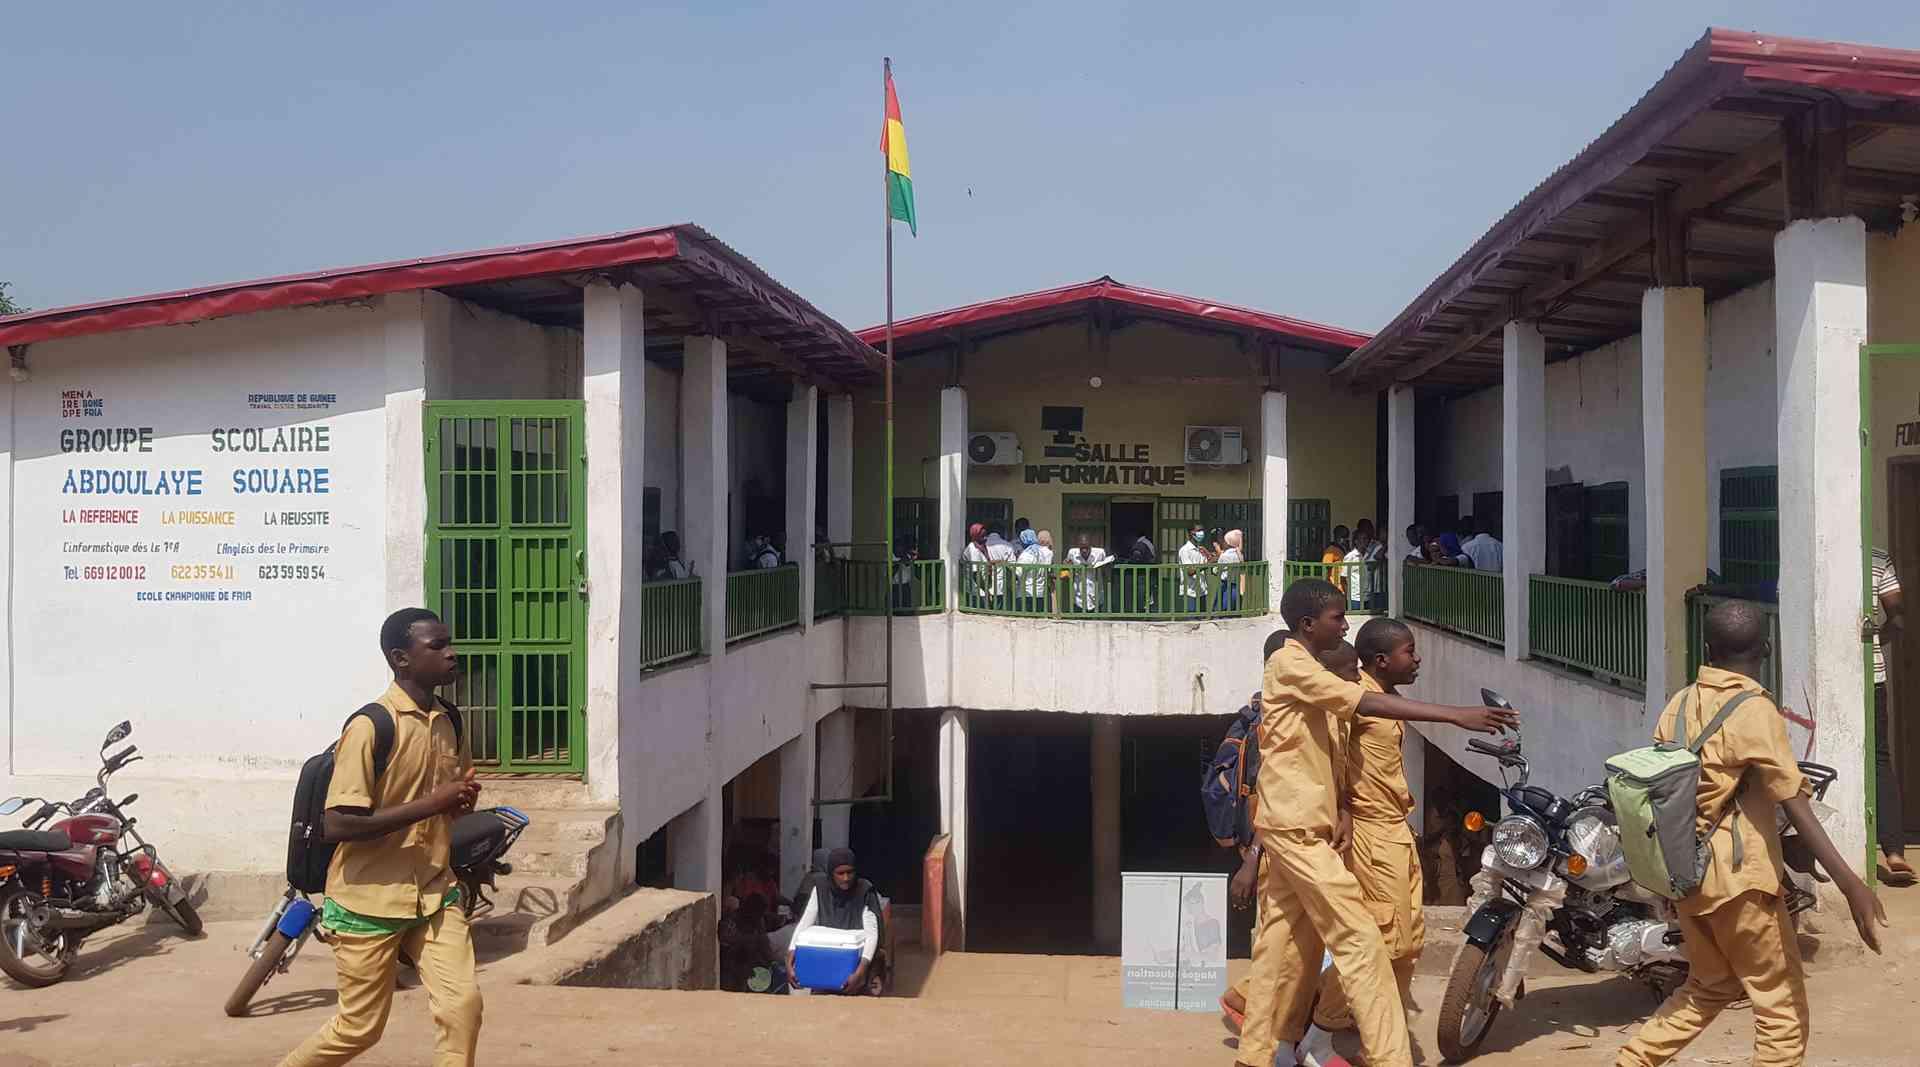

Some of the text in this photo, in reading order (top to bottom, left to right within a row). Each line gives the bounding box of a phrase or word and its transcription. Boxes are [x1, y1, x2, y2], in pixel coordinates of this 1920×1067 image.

[248, 394, 337, 403] REPUBLIQUE DE GUINEE
[84, 408, 103, 417] FRIA
[60, 426, 330, 453] GROUPE SCOLAIRE
[1075, 443, 1149, 463] SALLE
[62, 468, 329, 495] ABDOULAYE SOUARE
[1024, 465, 1185, 485] INFORMATIQUE
[63, 509, 139, 524] LA REFERENCE
[161, 511, 235, 525] LA PUISSANCE
[264, 511, 330, 526] LA REUSSITE
[289, 542, 330, 555] Primaire
[84, 566, 105, 580] 669
[258, 566, 279, 580] 623
[137, 591, 252, 601] ECOLE CHAMPIONNE DE FRIA
